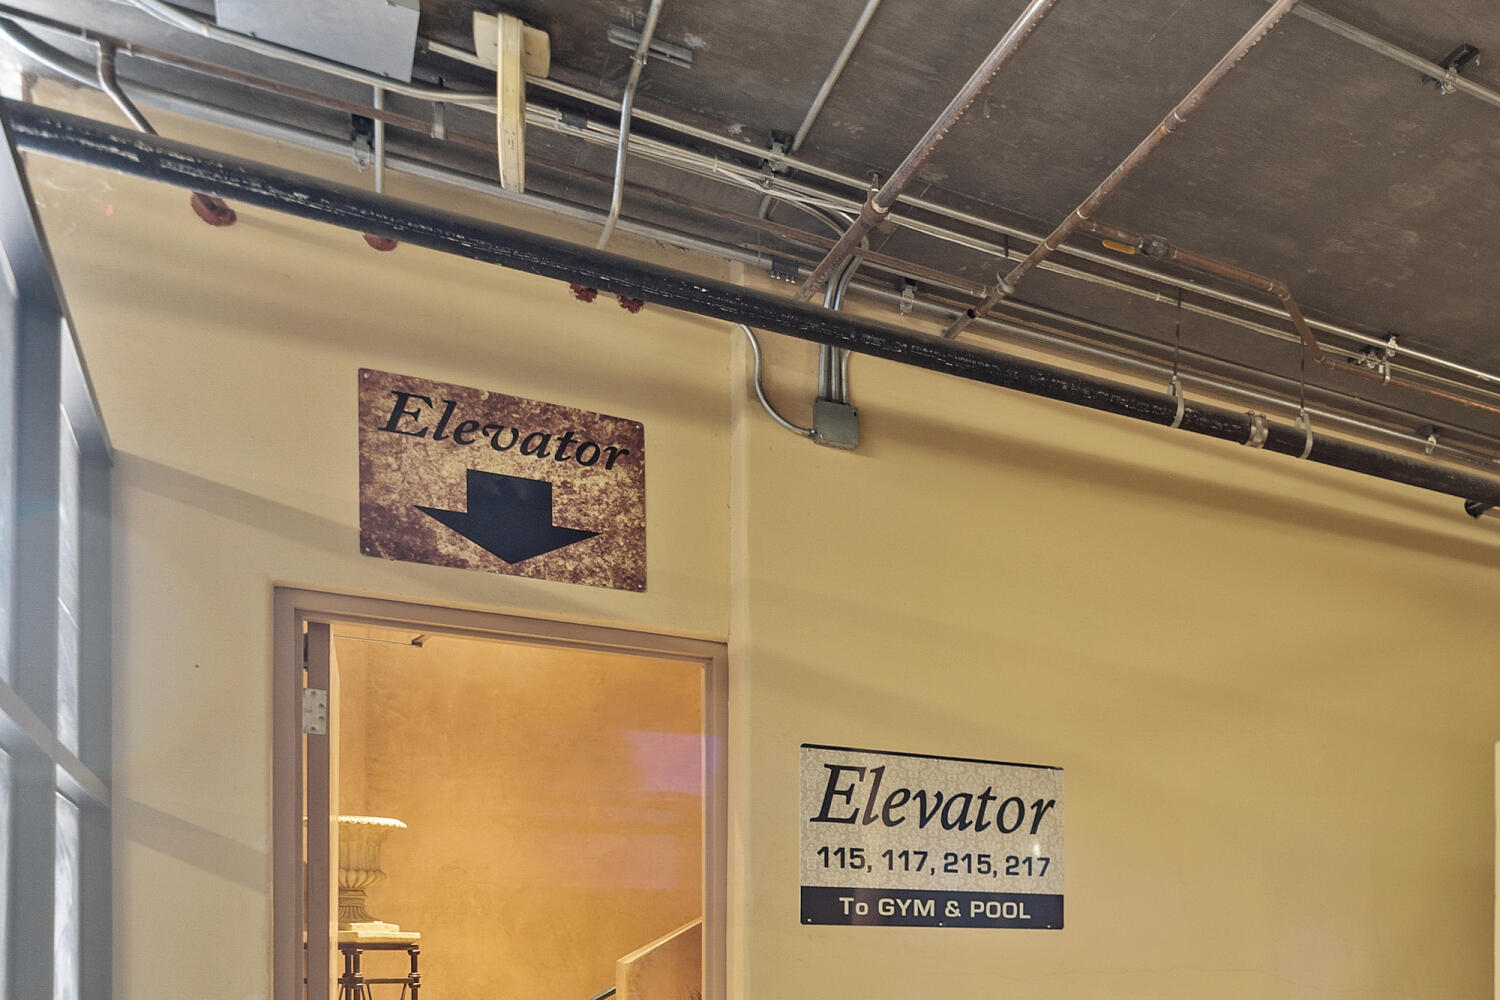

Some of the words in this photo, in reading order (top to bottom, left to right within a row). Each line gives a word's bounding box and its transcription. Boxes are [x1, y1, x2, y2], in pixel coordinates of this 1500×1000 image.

[377, 390, 630, 471] Elevator
[810, 763, 1056, 835] Elevator
[817, 846, 873, 872] 115,
[882, 850, 936, 875] 117,
[943, 853, 998, 878] 215,
[1005, 855, 1050, 877] 217
[839, 897, 869, 916] To
[878, 897, 935, 917] GYM
[945, 900, 961, 918] &
[970, 901, 1031, 920] POOL
